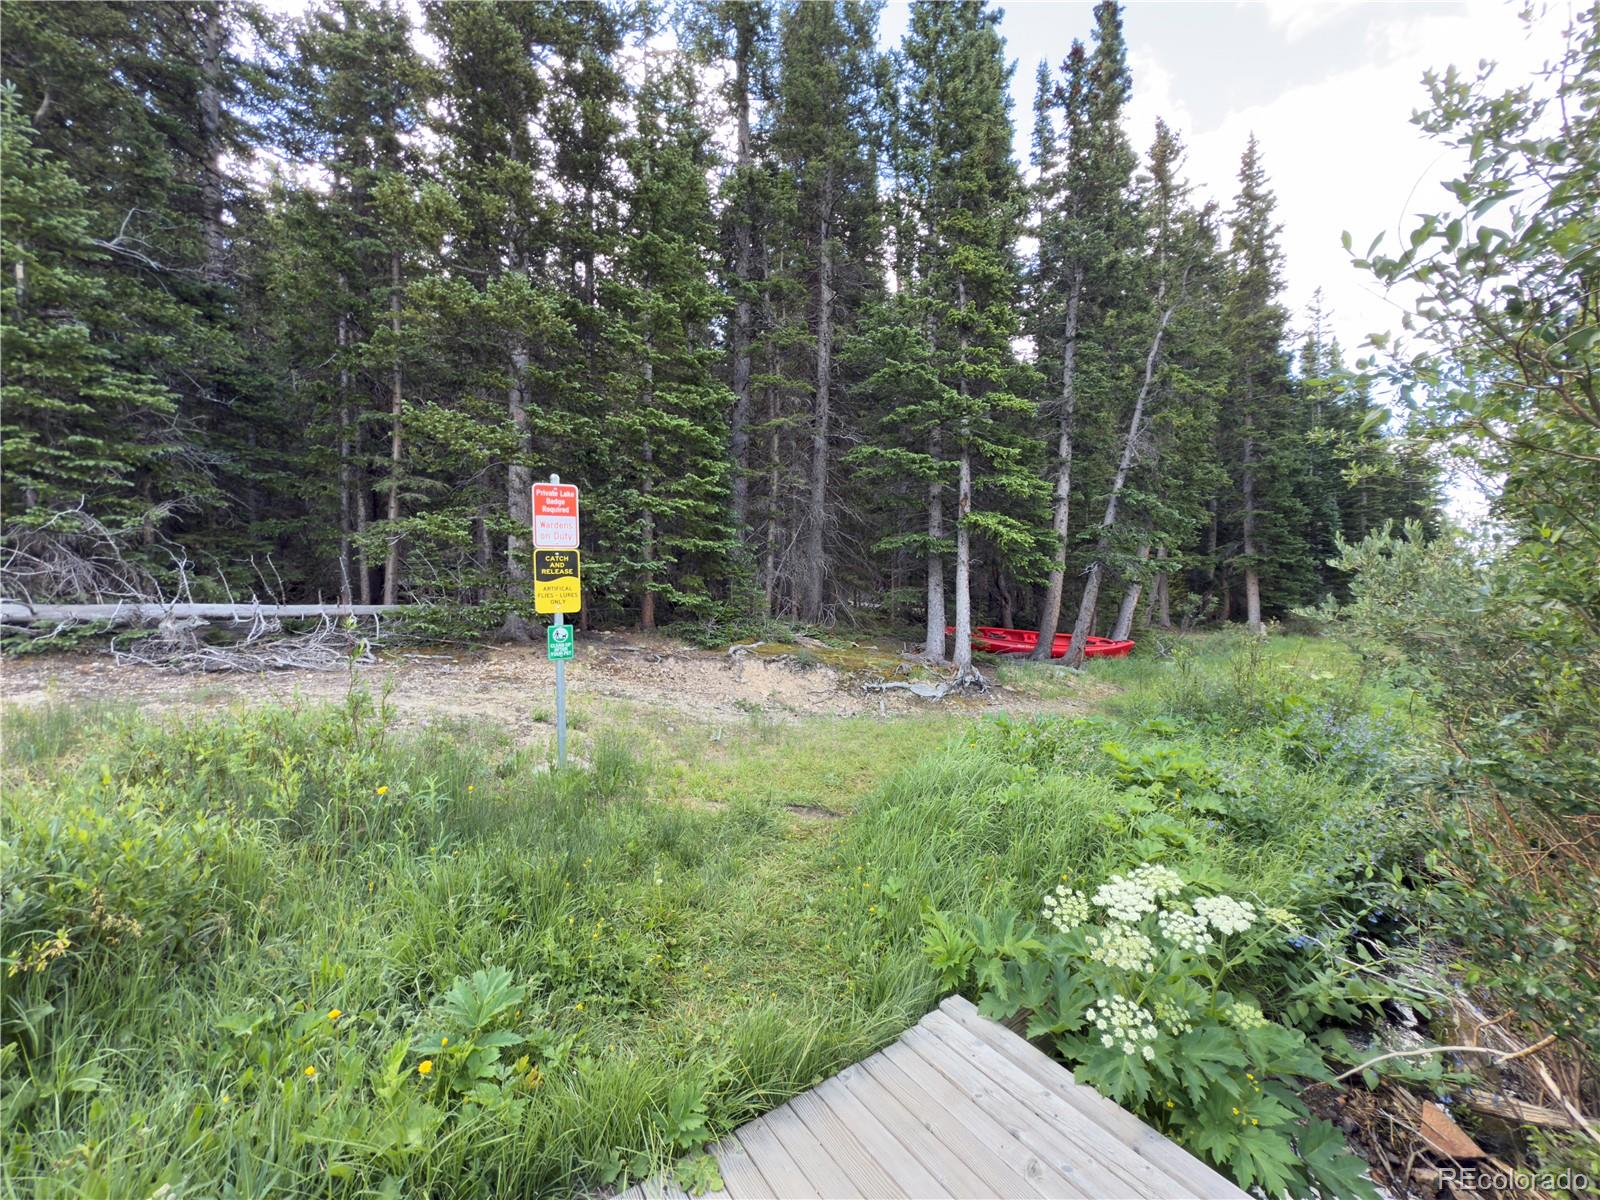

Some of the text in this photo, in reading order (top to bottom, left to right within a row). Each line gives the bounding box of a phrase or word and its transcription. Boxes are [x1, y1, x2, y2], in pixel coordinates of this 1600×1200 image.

[542, 506, 570, 514] Required
[540, 521, 574, 529] Wardens
[554, 532, 574, 542] Duty
